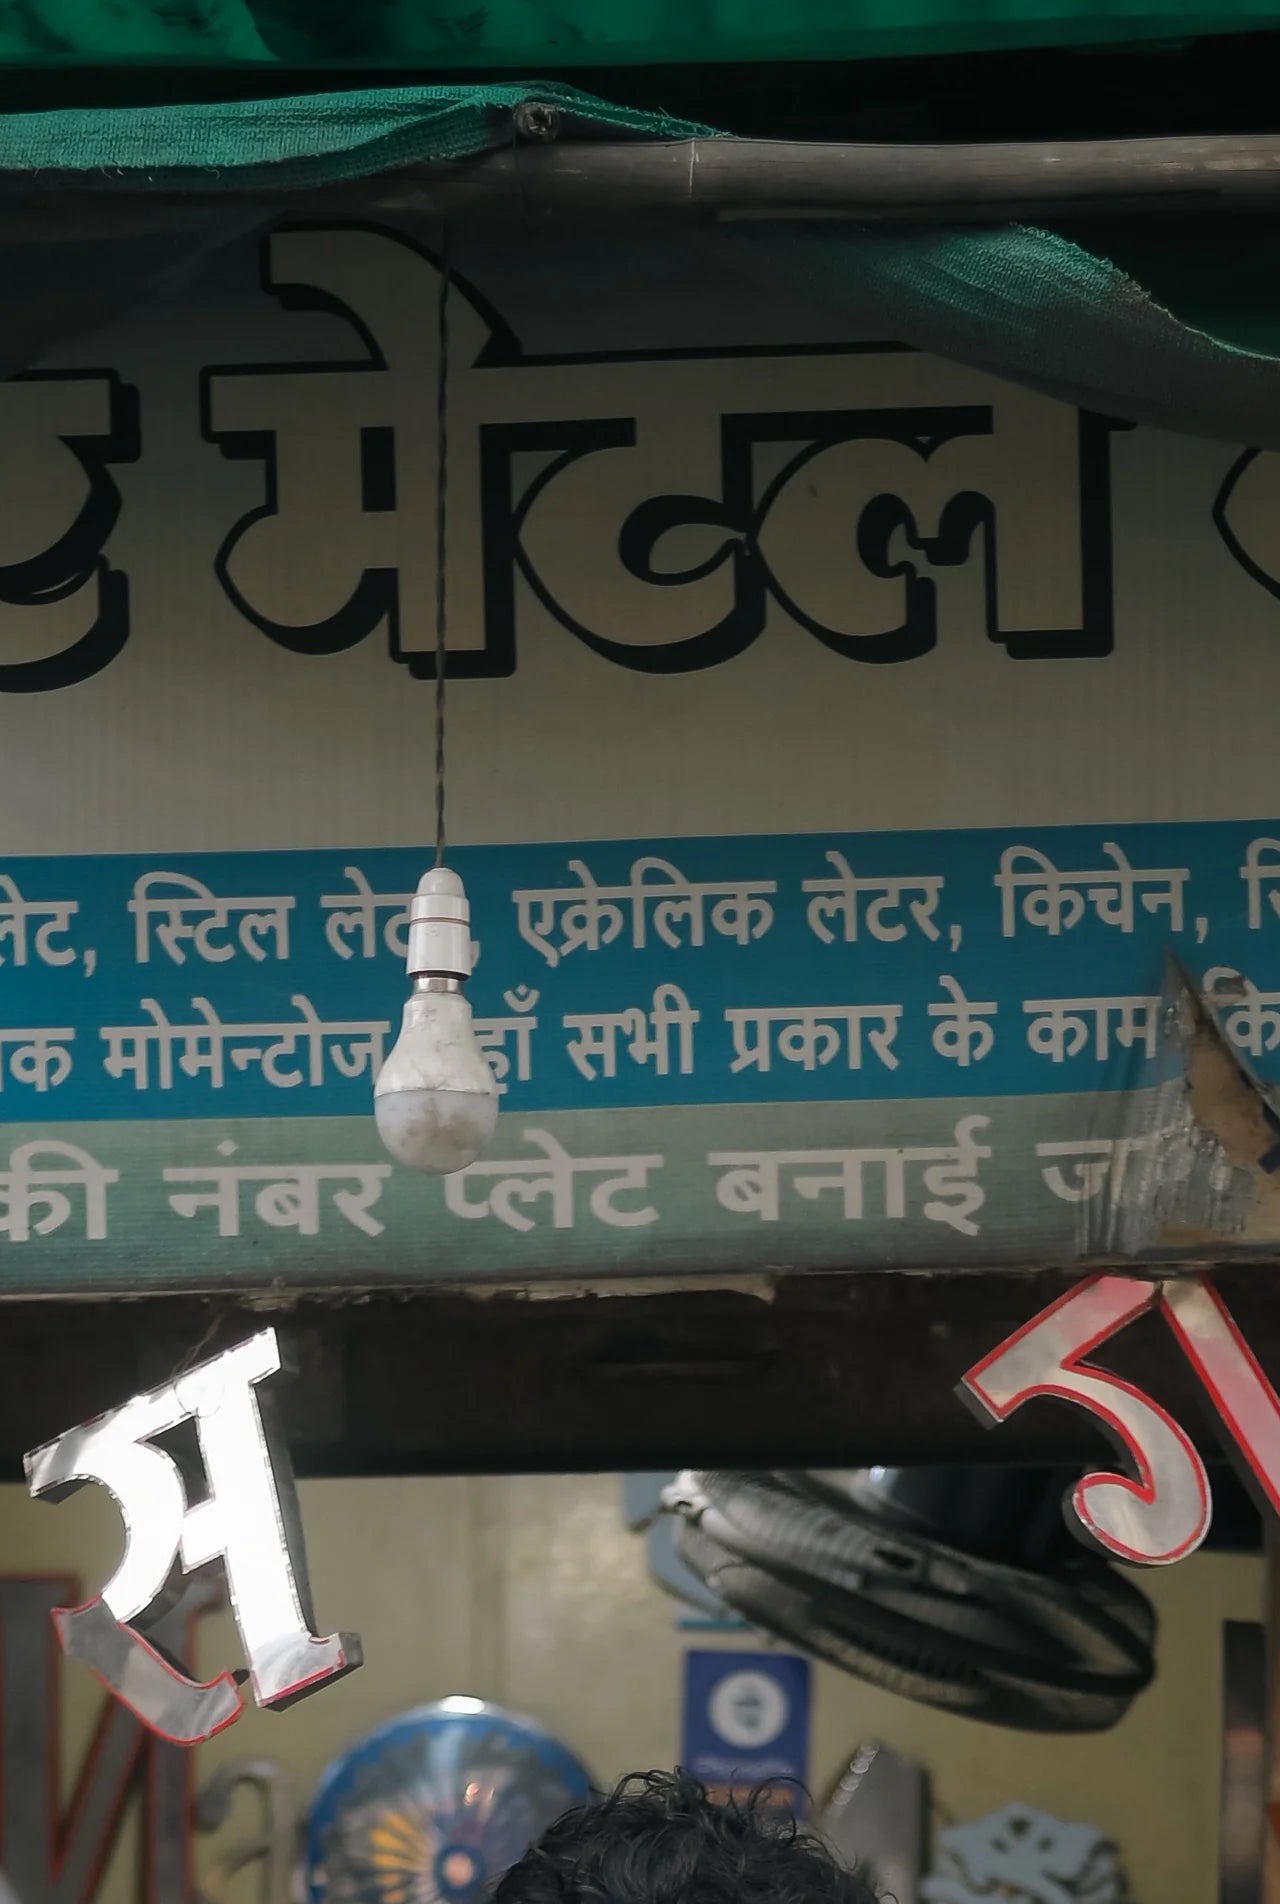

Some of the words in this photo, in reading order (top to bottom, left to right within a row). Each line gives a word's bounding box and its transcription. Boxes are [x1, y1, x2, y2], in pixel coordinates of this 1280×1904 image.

[201, 220, 1128, 678] मेटल
[128, 871, 296, 964] स्टिल
[511, 857, 777, 967] एक्रेलिक
[802, 851, 962, 952] लेटर,
[994, 842, 1208, 943] किचेन,
[563, 984, 700, 1080] सभी
[725, 1000, 903, 1073] प्रकार
[928, 975, 997, 1066] के
[1023, 988, 1162, 1062] काम
[165, 1137, 390, 1235] नंबर
[444, 1128, 664, 1233] प्लेट
[708, 1115, 990, 1236] बनाई
